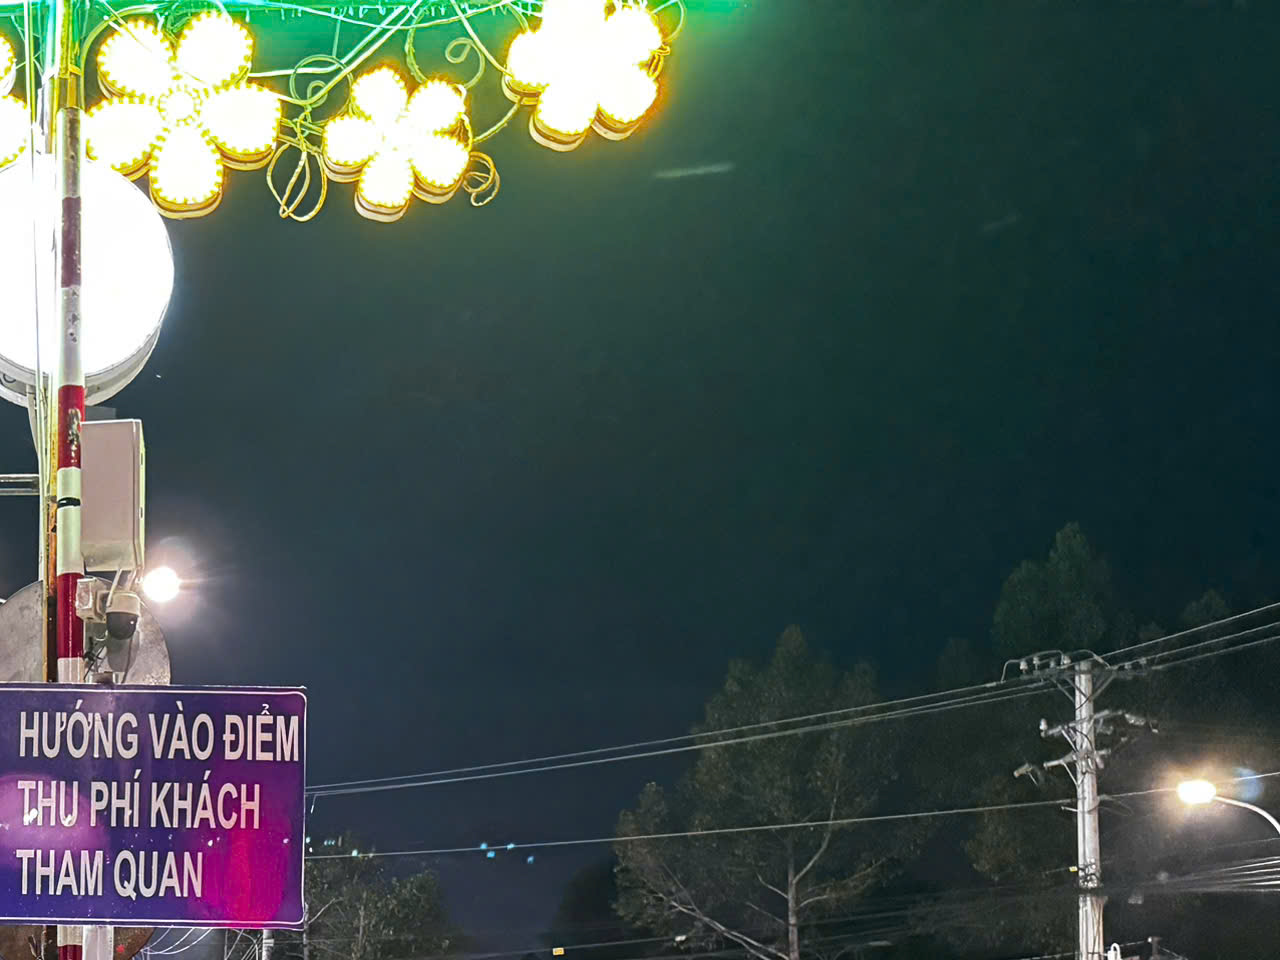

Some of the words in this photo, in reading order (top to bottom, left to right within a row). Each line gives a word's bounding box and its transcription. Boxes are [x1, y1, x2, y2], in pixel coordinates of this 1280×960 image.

[19, 700, 139, 760] HƯỚNG
[148, 701, 214, 760] VÀO
[222, 704, 300, 762] ĐIỂM
[17, 780, 79, 828] THU
[90, 769, 141, 828] PHÍ
[150, 769, 260, 830] KHÁCH
[16, 849, 104, 897] THAM
[113, 850, 203, 901] QUAN
